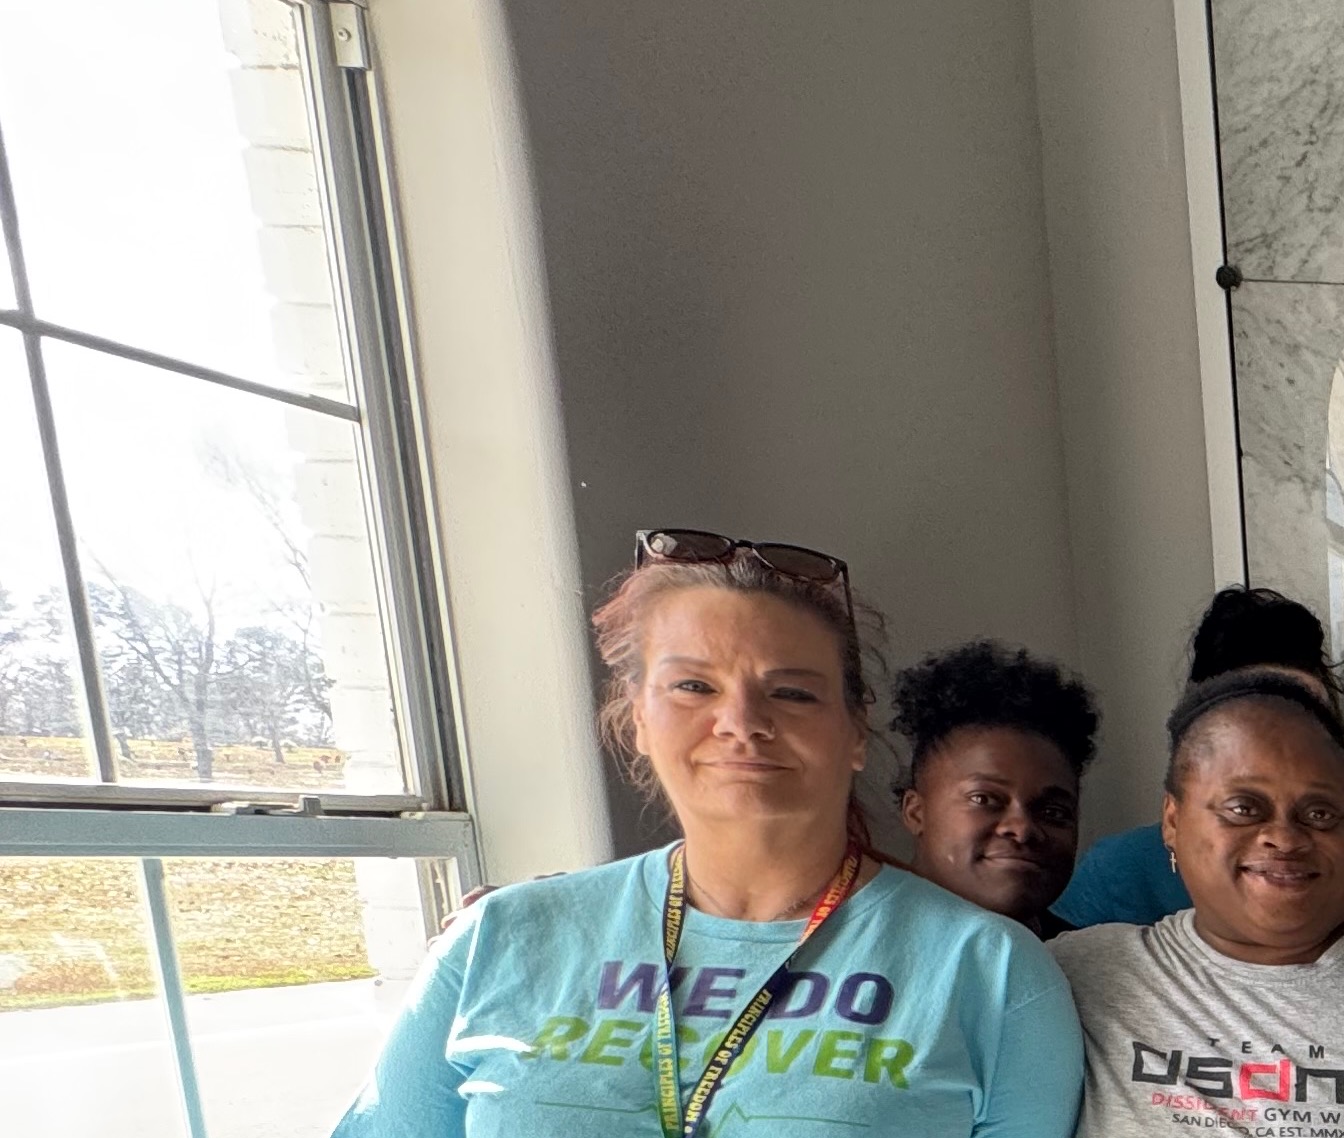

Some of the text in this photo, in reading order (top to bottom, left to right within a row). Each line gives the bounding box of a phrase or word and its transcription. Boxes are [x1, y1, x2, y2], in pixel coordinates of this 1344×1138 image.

[597, 960, 895, 1026] WE DO
[518, 1014, 914, 1091] RECOVER
[657, 1041, 673, 1056] OF
[685, 988, 773, 1123] PRINCIPLES OF FREEDOM
[1208, 1037, 1325, 1059] TEAM
[659, 1058, 680, 1131] PRINCIPLES
[1264, 1108, 1311, 1123] GYM
[1172, 1114, 1200, 1126] SAN
[1255, 1127, 1275, 1138] CA
